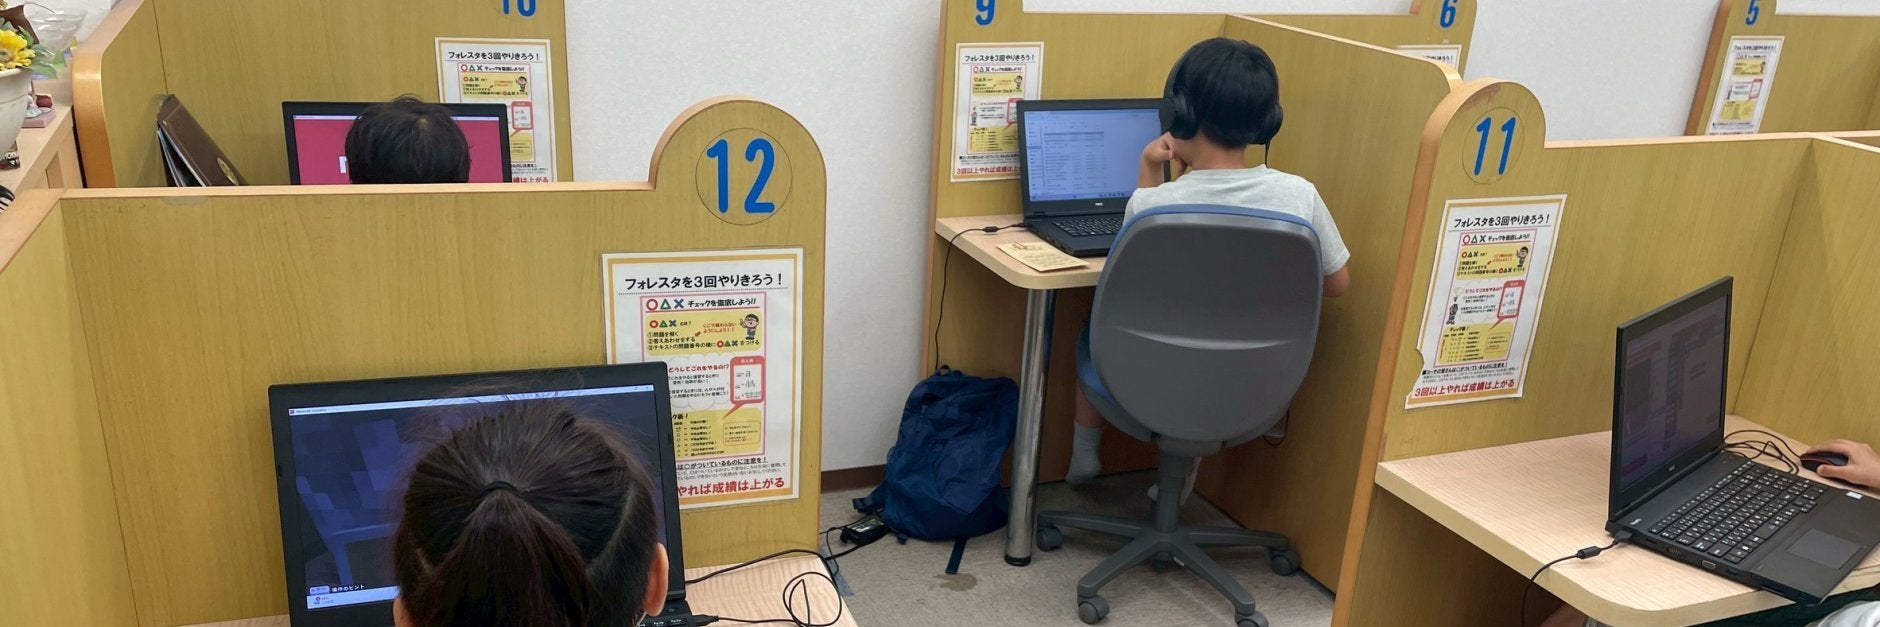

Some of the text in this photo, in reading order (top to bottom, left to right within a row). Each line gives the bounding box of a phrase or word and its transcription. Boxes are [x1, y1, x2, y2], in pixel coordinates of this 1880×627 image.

[975, 0, 995, 25] 9
[448, 51, 540, 61] フォレスタを3回やりきろう！
[964, 54, 1035, 62] フォレスタを3回やりきろう！
[1474, 117, 1517, 175] 11
[707, 138, 775, 213] 12
[1453, 213, 1551, 229] フォレスタを3回やりきろう！
[624, 273, 783, 291] フォレスタを3回やりきろう！
[1414, 379, 1515, 397] 3回以上やれば成績は上がる
[677, 477, 785, 497] やれば成績は上がる
